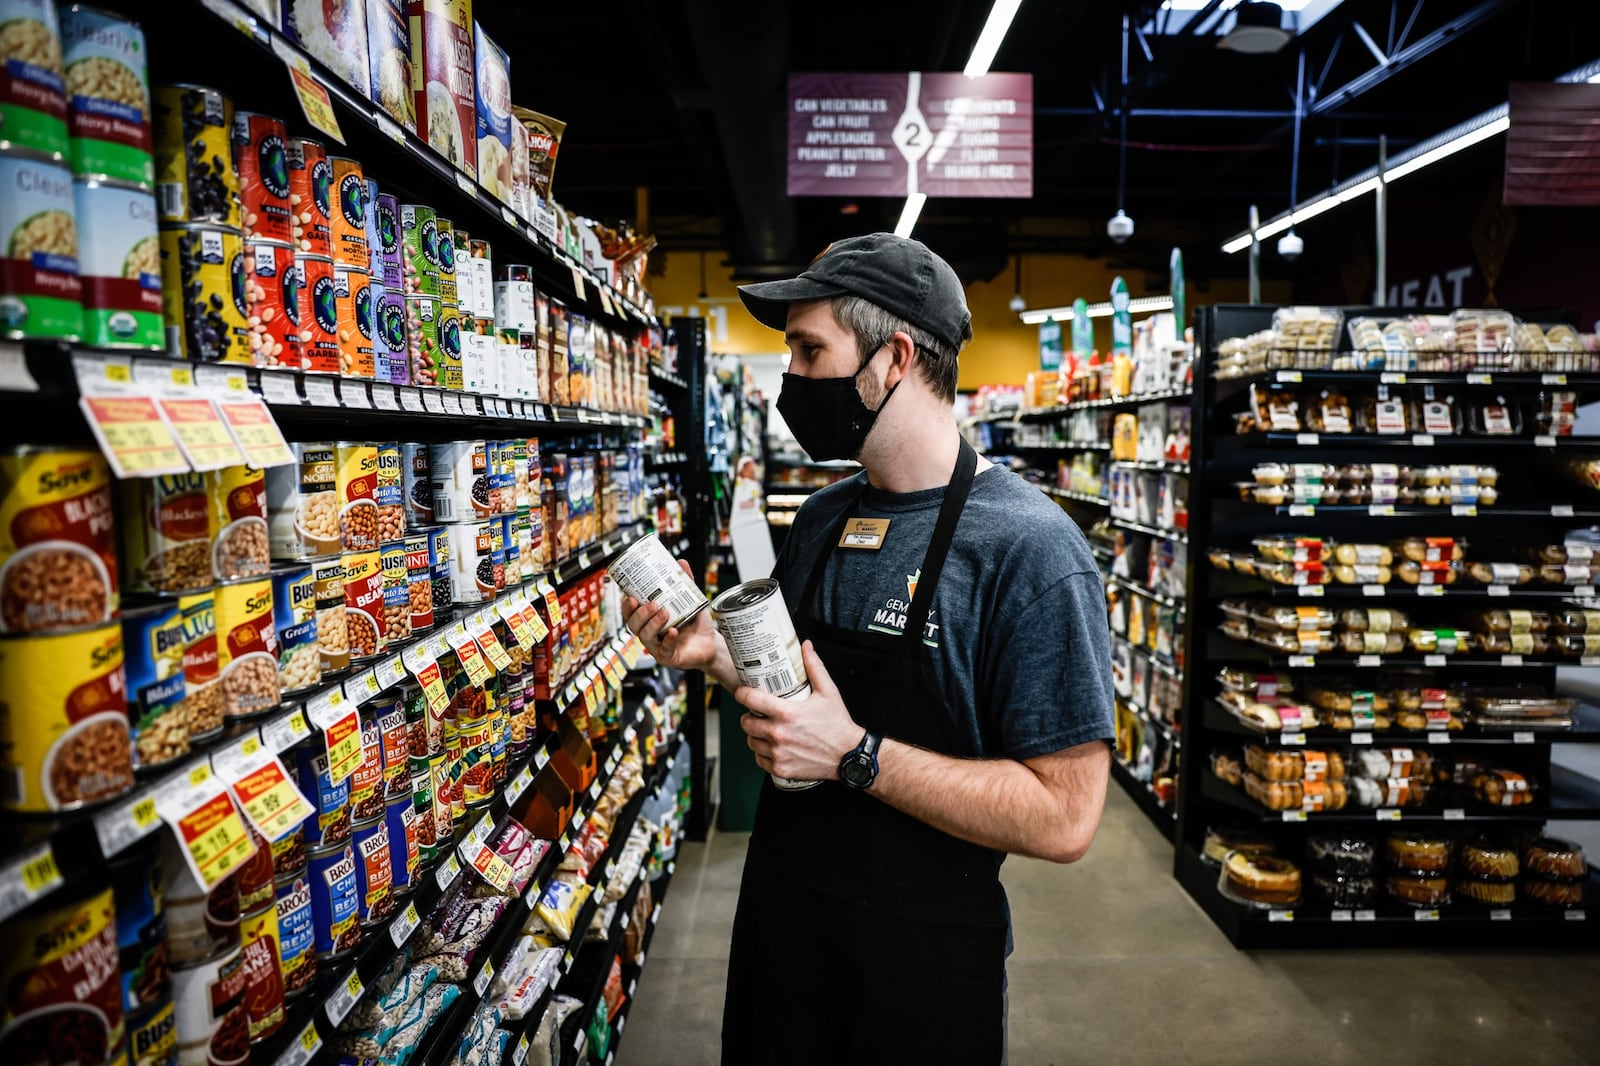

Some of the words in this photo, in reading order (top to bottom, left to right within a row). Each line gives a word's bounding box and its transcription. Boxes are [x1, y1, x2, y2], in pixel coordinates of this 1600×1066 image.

[795, 100, 818, 112] CAN
[820, 100, 887, 112] VEGETABLES
[812, 116, 836, 127] CAN
[838, 116, 869, 127] FRUIT
[806, 132, 875, 145] APPLESAUCE
[905, 123, 921, 146] 2
[798, 148, 841, 160] PEANUT
[843, 148, 885, 160] BUTTER
[824, 165, 857, 177] JELLY
[317, 567, 334, 580] Best
[342, 563, 368, 578] Save
[886, 598, 909, 613] GEM
[873, 609, 940, 638] MART
[460, 734, 482, 748] RED
[293, 920, 310, 935] MILD
